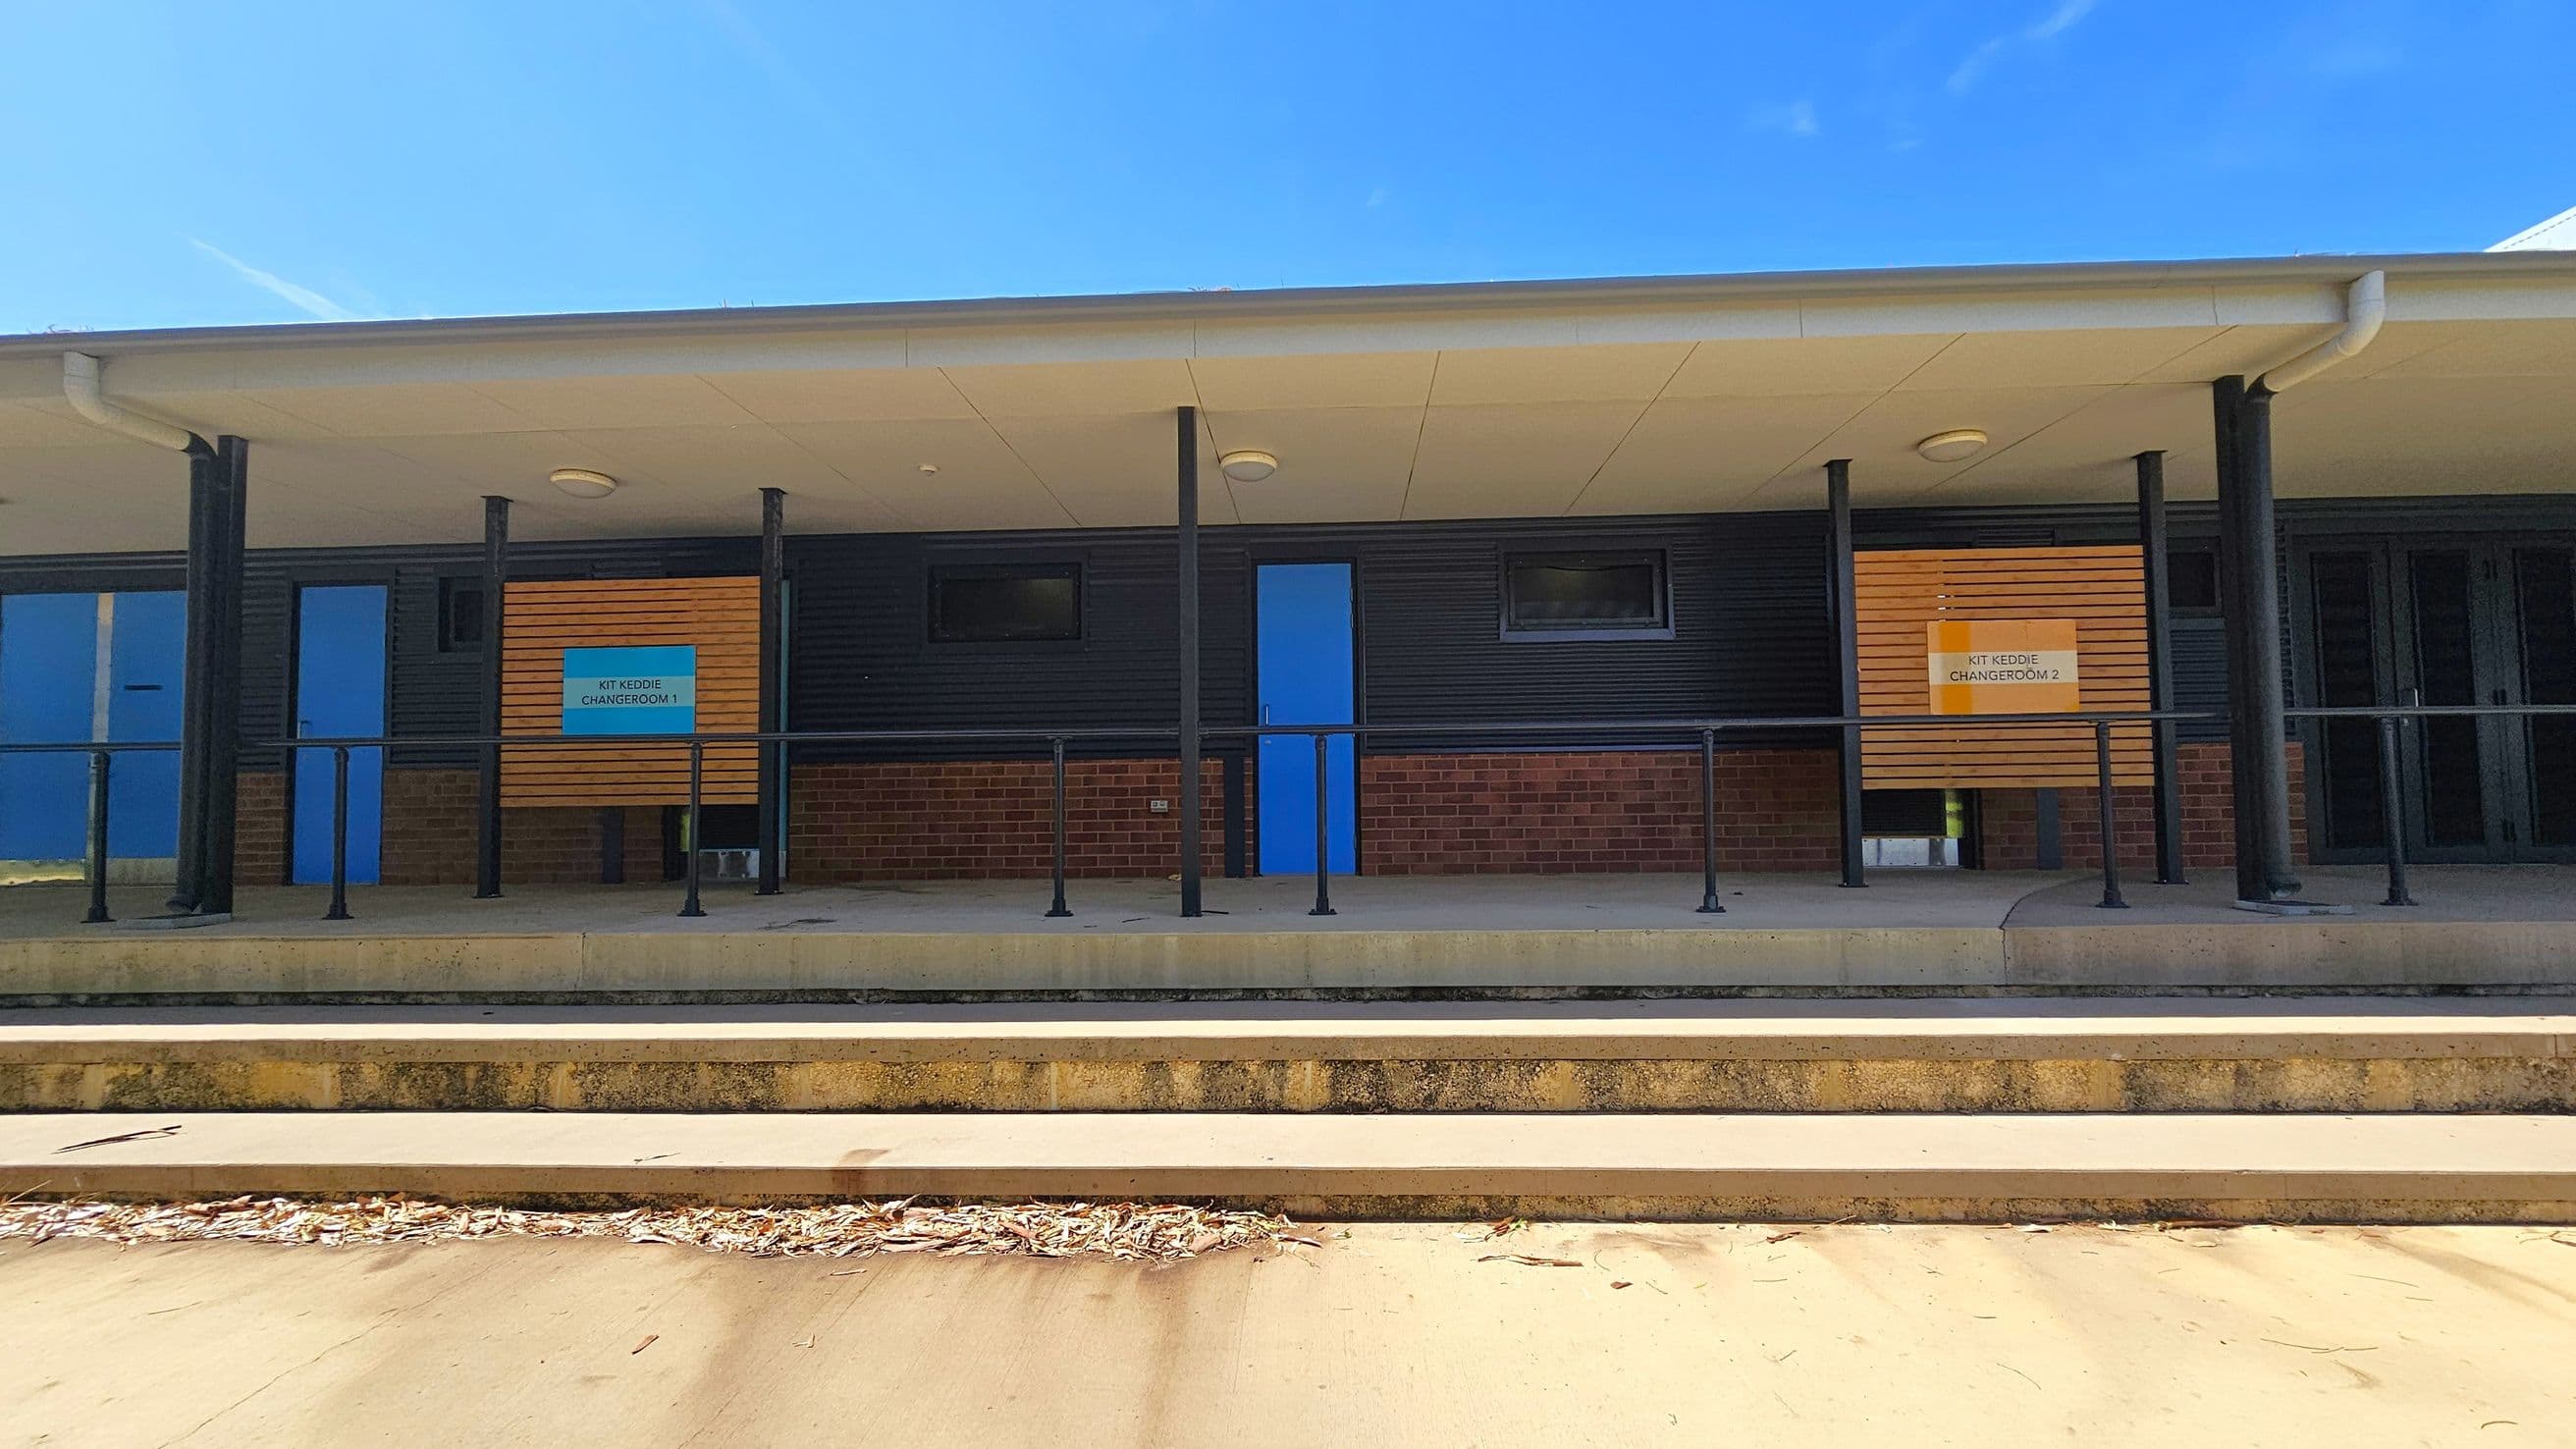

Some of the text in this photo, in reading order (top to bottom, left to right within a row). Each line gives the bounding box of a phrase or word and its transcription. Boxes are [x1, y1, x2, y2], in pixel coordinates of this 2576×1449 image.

[1968, 654, 2039, 666] KIT KEDDIE
[1950, 670, 2060, 681] CHANGEROOM 2
[599, 679, 661, 690] KIT KEDDIE
[581, 694, 677, 705] CHANGEROOM 1
